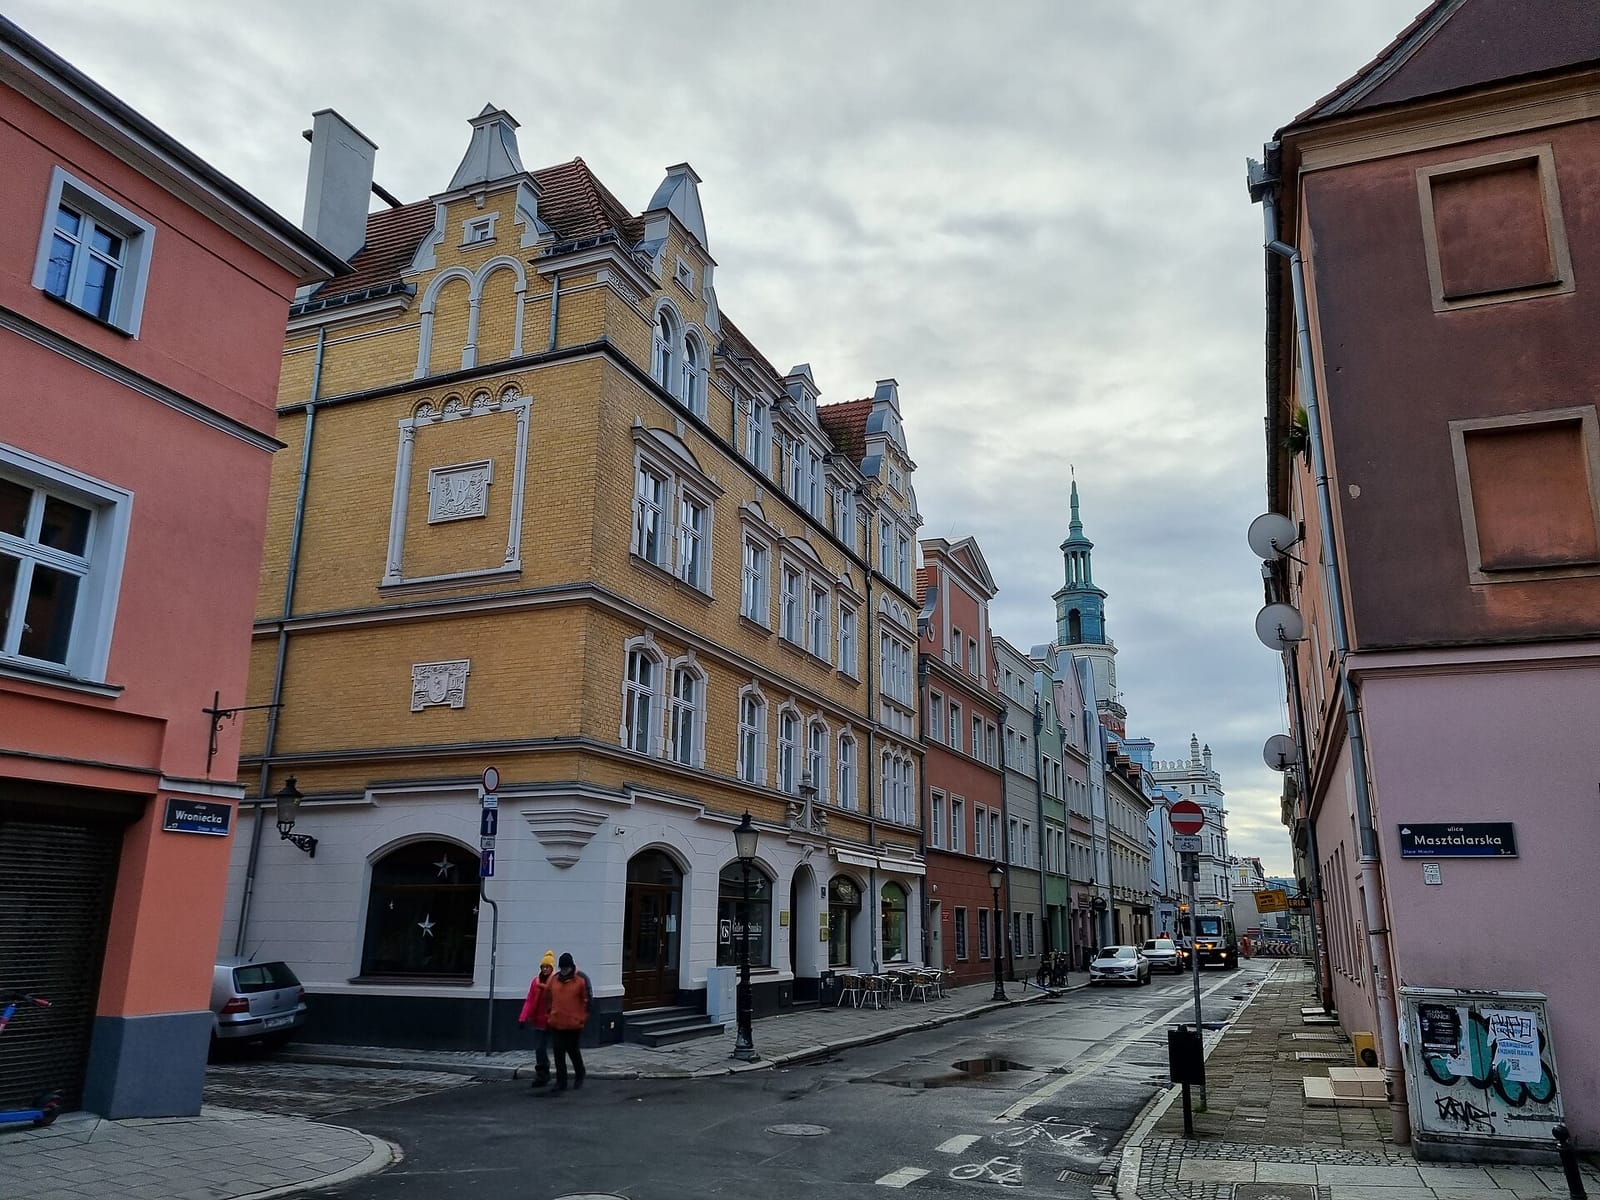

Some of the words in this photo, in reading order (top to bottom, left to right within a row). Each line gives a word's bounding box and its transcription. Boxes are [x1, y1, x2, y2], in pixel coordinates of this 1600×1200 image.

[175, 810, 223, 824] Wroniecka
[1414, 835, 1502, 845] Masztalarska
[1288, 899, 1306, 907] ERIA
